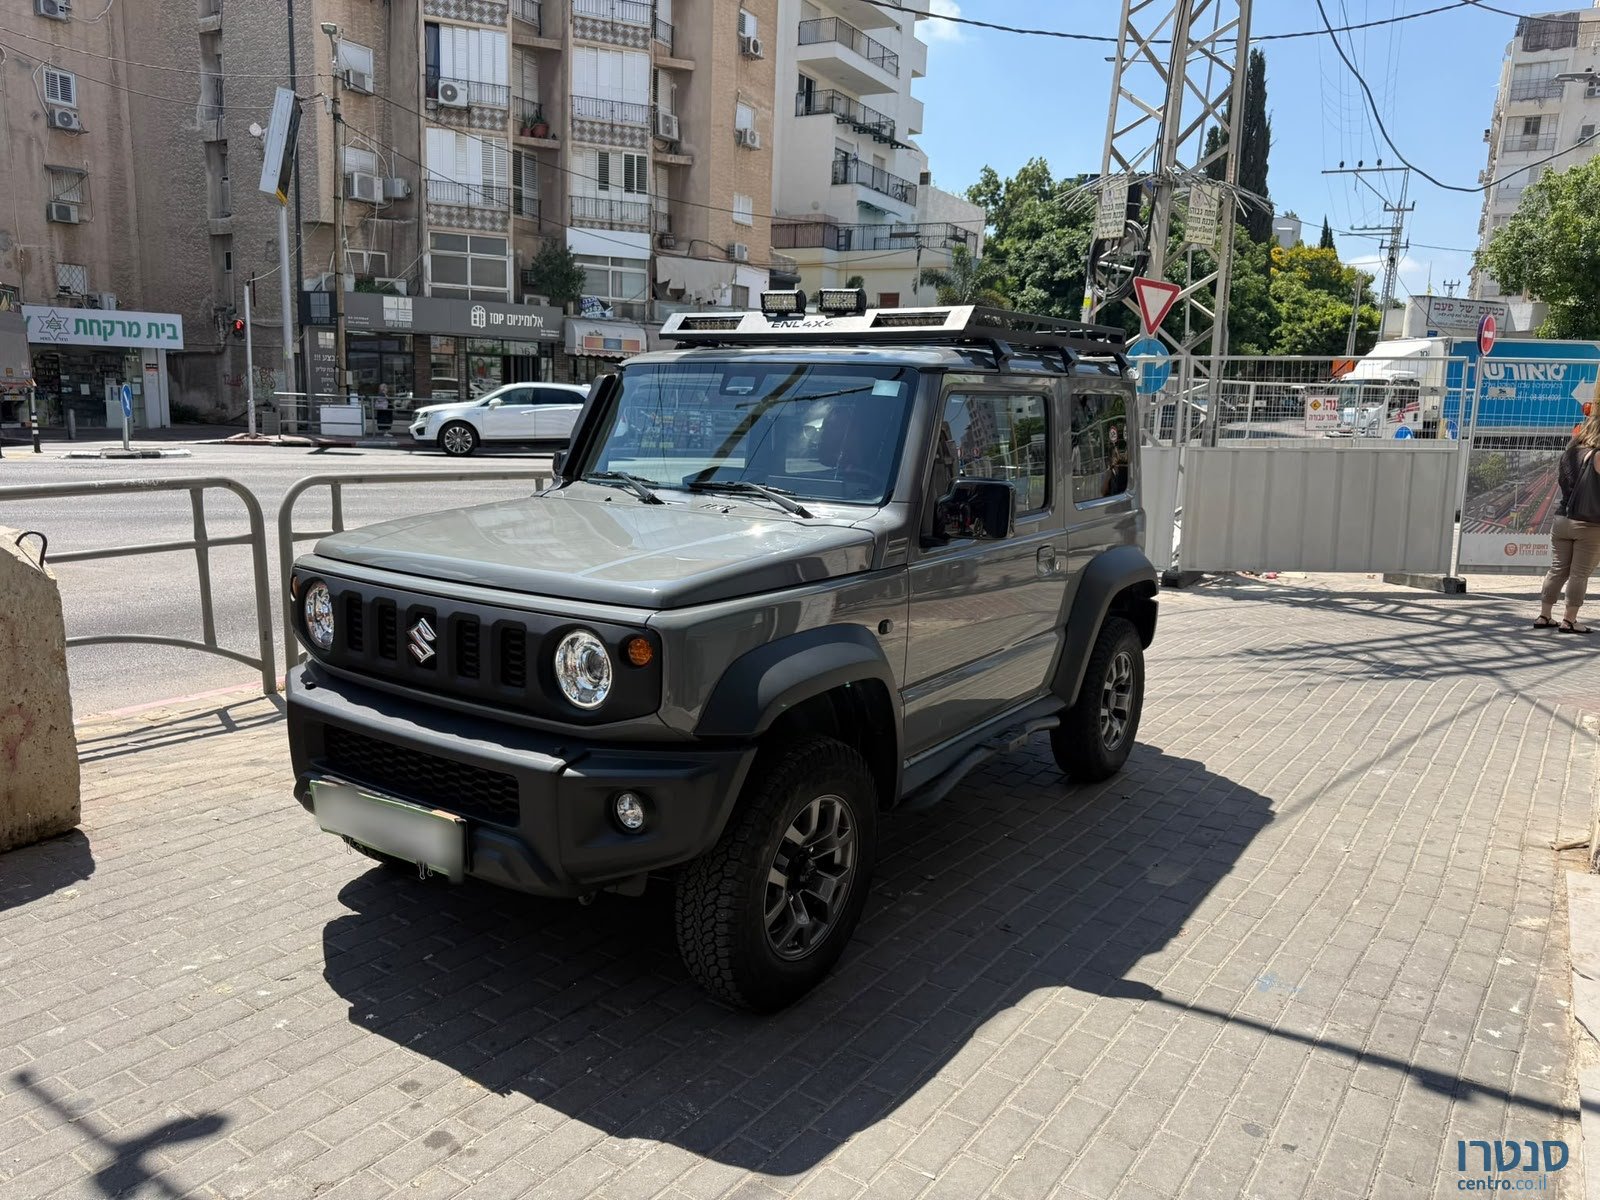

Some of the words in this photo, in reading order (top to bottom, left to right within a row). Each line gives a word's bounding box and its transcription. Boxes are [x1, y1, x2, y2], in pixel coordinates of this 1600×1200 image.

[1433, 302, 1454, 311] פעם
[1459, 302, 1474, 314] של
[1478, 305, 1504, 316] בטעם
[489, 312, 504, 325] TOP
[507, 314, 544, 328] אלומיניום
[74, 318, 141, 341] מרקחת
[146, 322, 179, 340] בית
